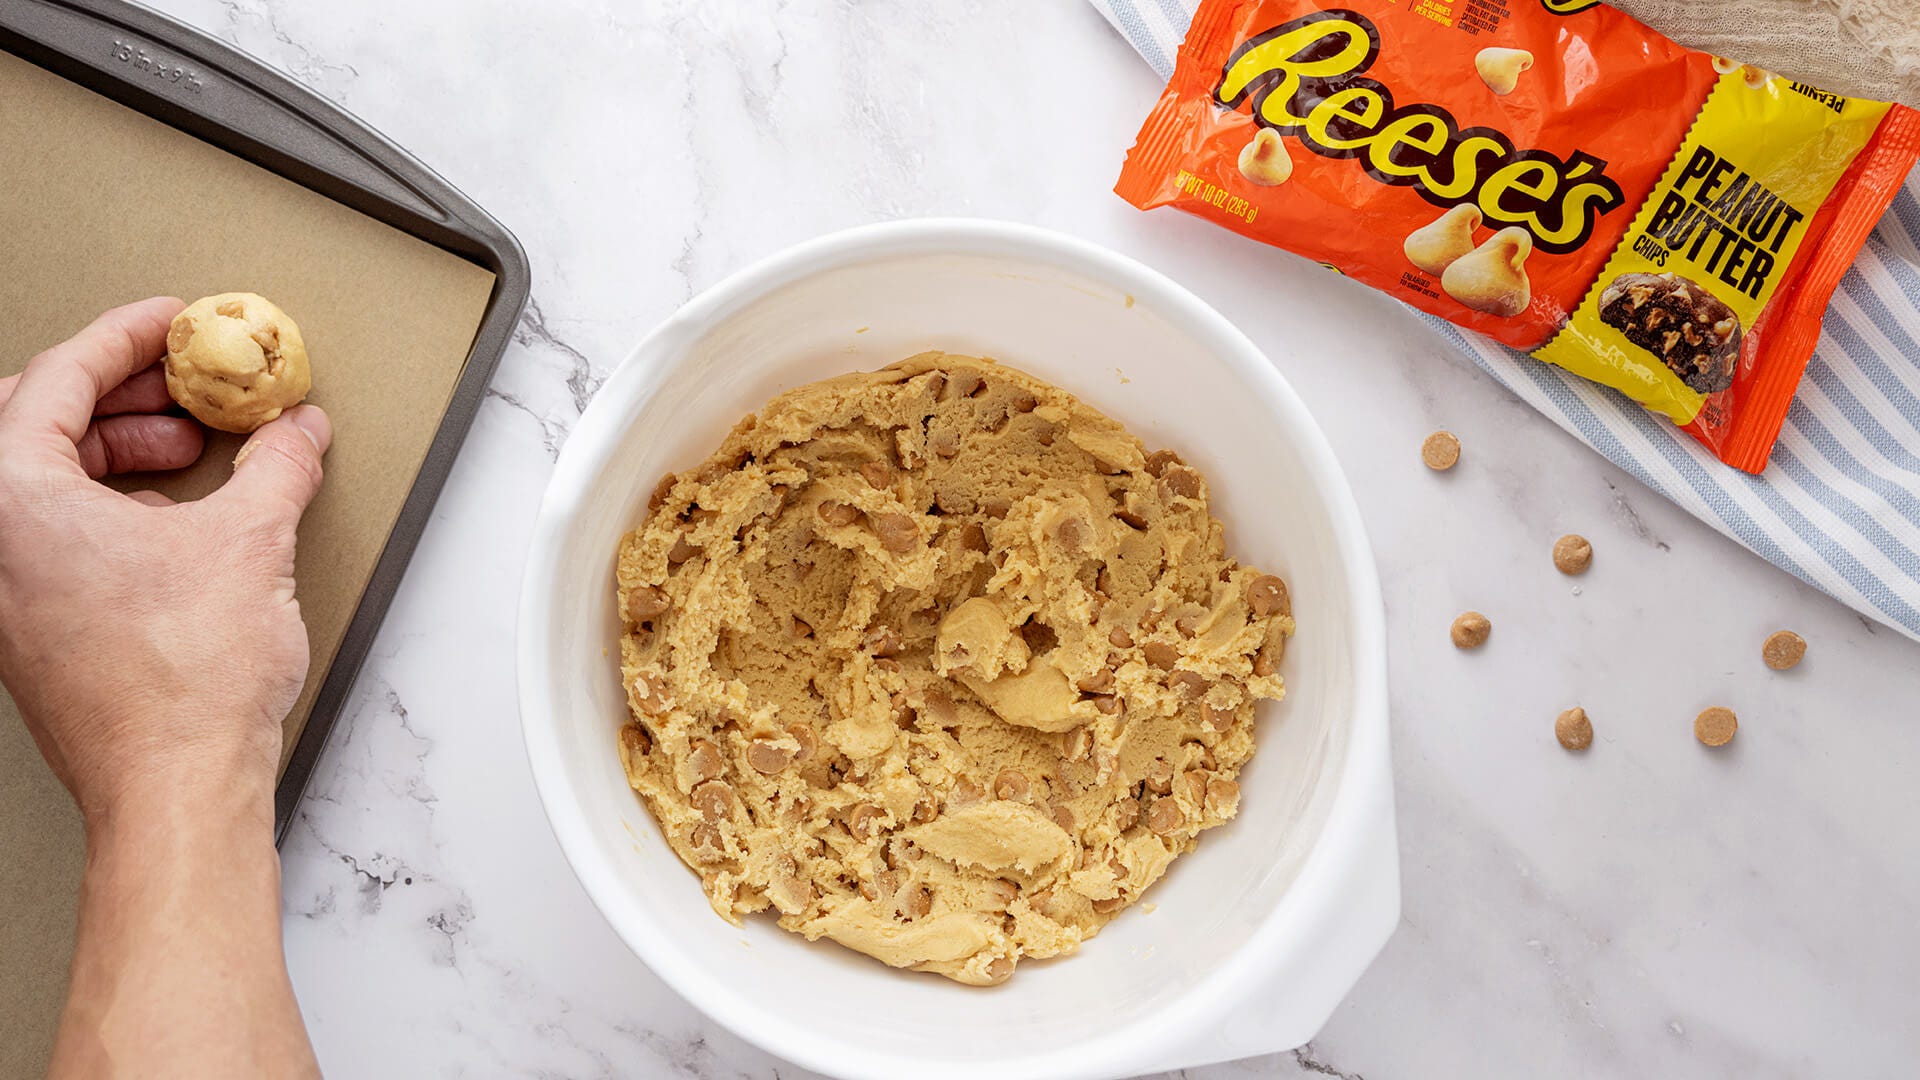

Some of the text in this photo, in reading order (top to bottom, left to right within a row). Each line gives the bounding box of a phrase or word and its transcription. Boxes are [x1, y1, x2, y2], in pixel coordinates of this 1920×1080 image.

[1414, 5, 1453, 27] PER SERVING
[1423, 0, 1452, 16] CALORIES
[1465, 3, 1479, 16] TOTAL
[1480, 10, 1490, 19] FAT
[1489, 14, 1500, 24] AND
[1457, 20, 1480, 35] CONTENT
[1487, 24, 1498, 33] FAT
[111, 40, 132, 62] 13
[134, 50, 151, 72] in
[170, 68, 183, 83] 9
[184, 73, 202, 94] in
[1216, 12, 1620, 250] Reese's
[1201, 183, 1215, 202] 10
[1212, 189, 1229, 208] OZ
[1225, 196, 1249, 217] (283
[1246, 206, 1259, 224] g)
[1673, 145, 1804, 254] PEANUT
[1633, 235, 1669, 267] CHIPS
[1645, 190, 1775, 300] BUTTER
